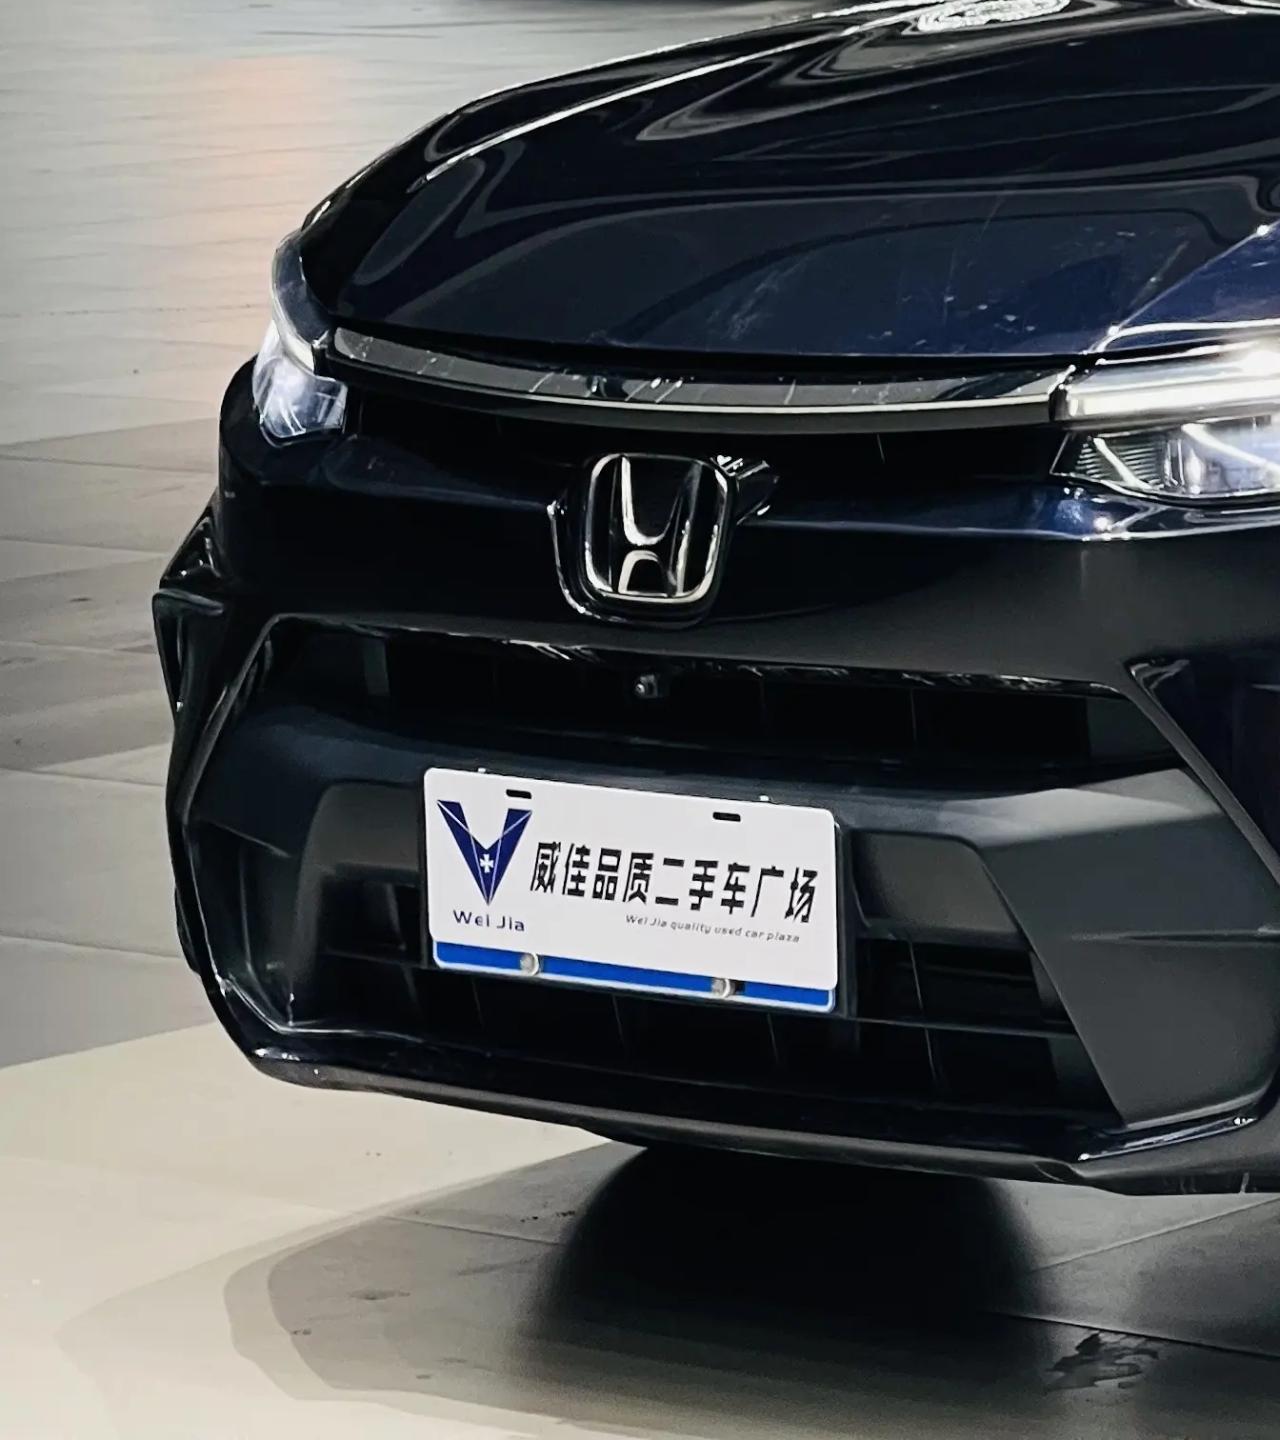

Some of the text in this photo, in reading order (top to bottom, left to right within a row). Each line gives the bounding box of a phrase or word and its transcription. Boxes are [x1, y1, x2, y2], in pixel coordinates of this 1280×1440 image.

[530, 841, 818, 924] 威佳品质二手车广场
[453, 910, 525, 932] Wei Jia
[626, 914, 800, 943] Wei Jia quality used car plaza
